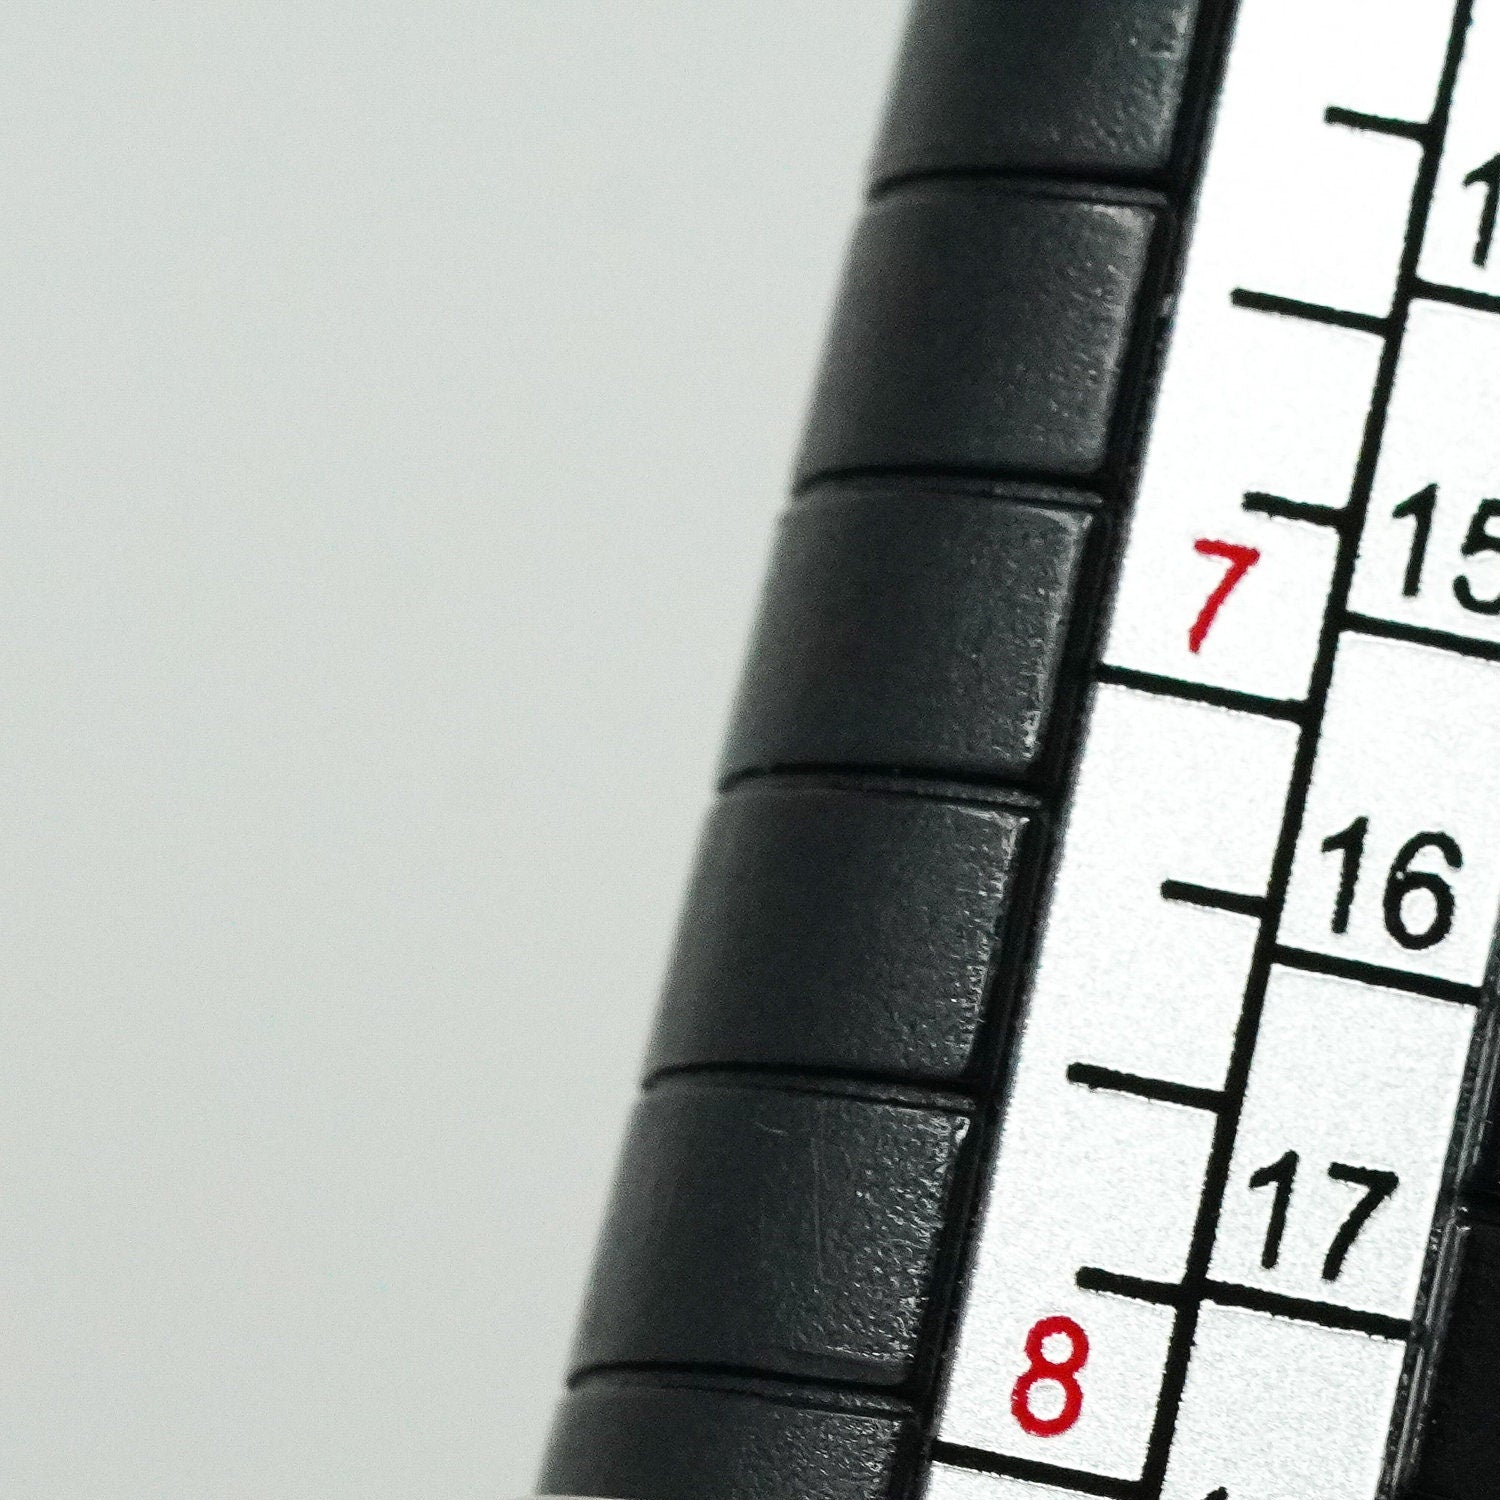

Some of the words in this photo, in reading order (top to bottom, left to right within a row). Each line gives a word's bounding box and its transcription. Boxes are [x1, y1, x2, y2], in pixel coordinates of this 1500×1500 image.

[1190, 538, 1261, 653] 7
[1321, 816, 1464, 951] 16
[1248, 1150, 1398, 1283] 17
[1010, 1315, 1090, 1438] 8
